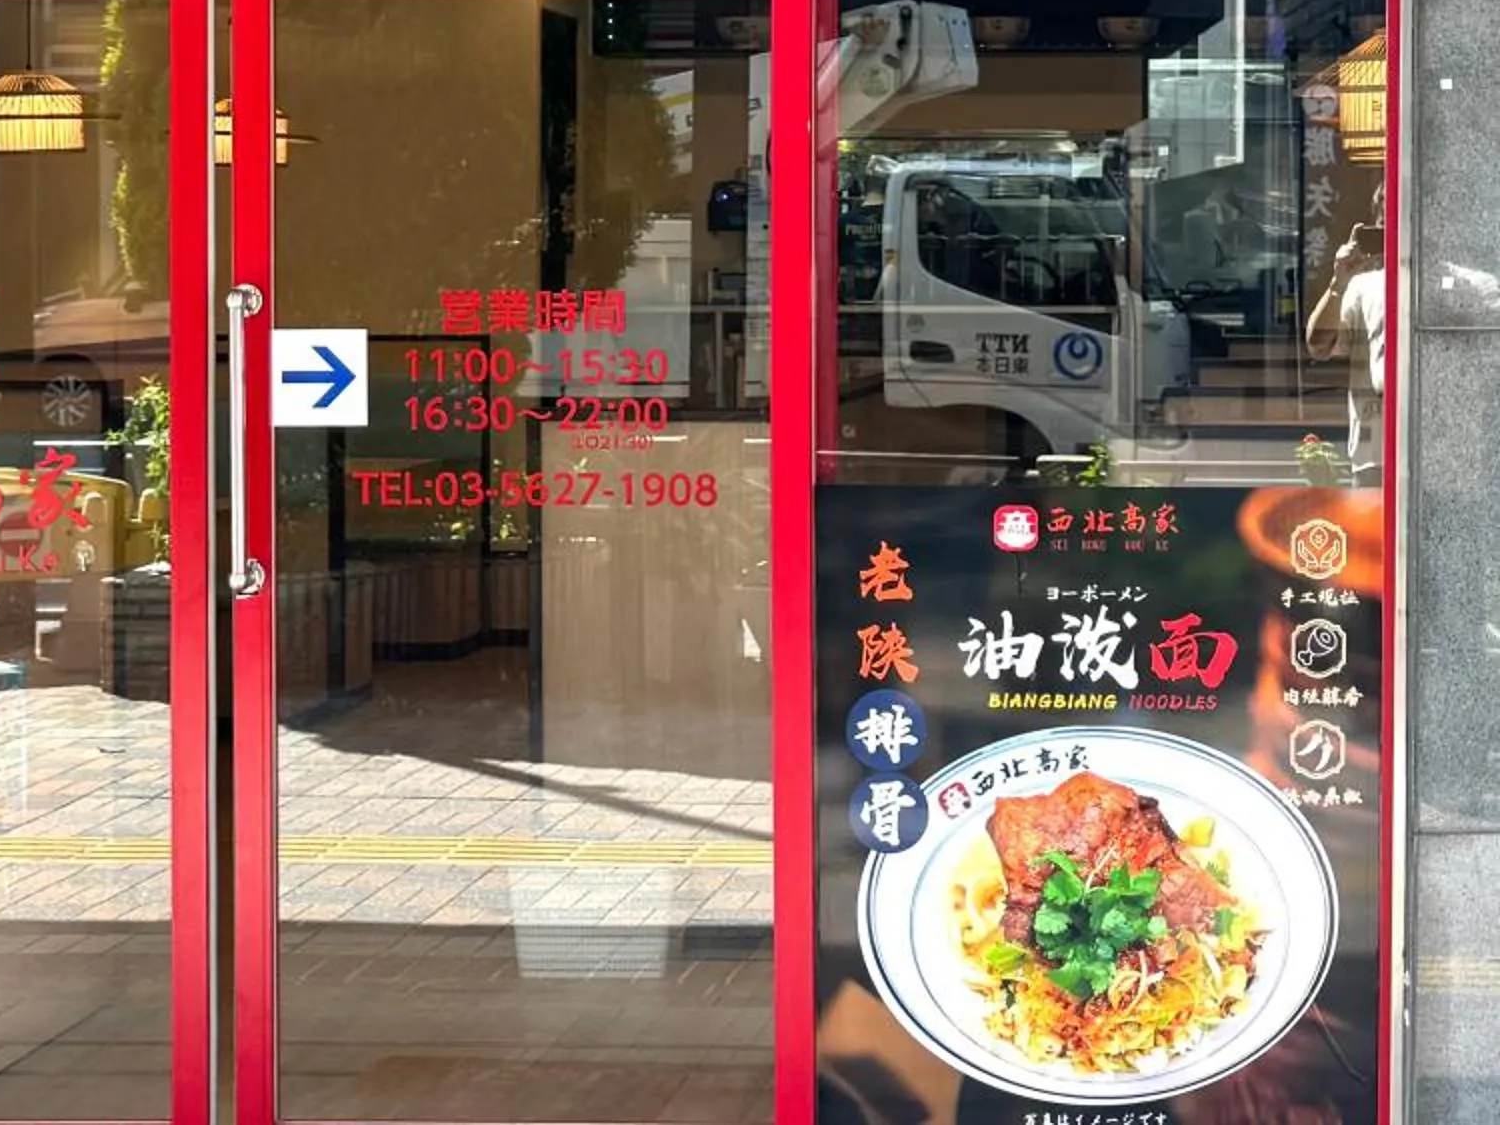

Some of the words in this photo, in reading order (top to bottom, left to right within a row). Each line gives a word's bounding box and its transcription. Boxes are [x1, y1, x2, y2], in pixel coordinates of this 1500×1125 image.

[440, 289, 627, 335] 営業時間
[353, 471, 719, 508] TEL:03-5627-1908
[1046, 501, 1180, 535] 西北高家
[988, 692, 1118, 711] BIANGBIANG
[1128, 693, 1219, 711] NOODLES
[971, 744, 1090, 796] 西北高家
